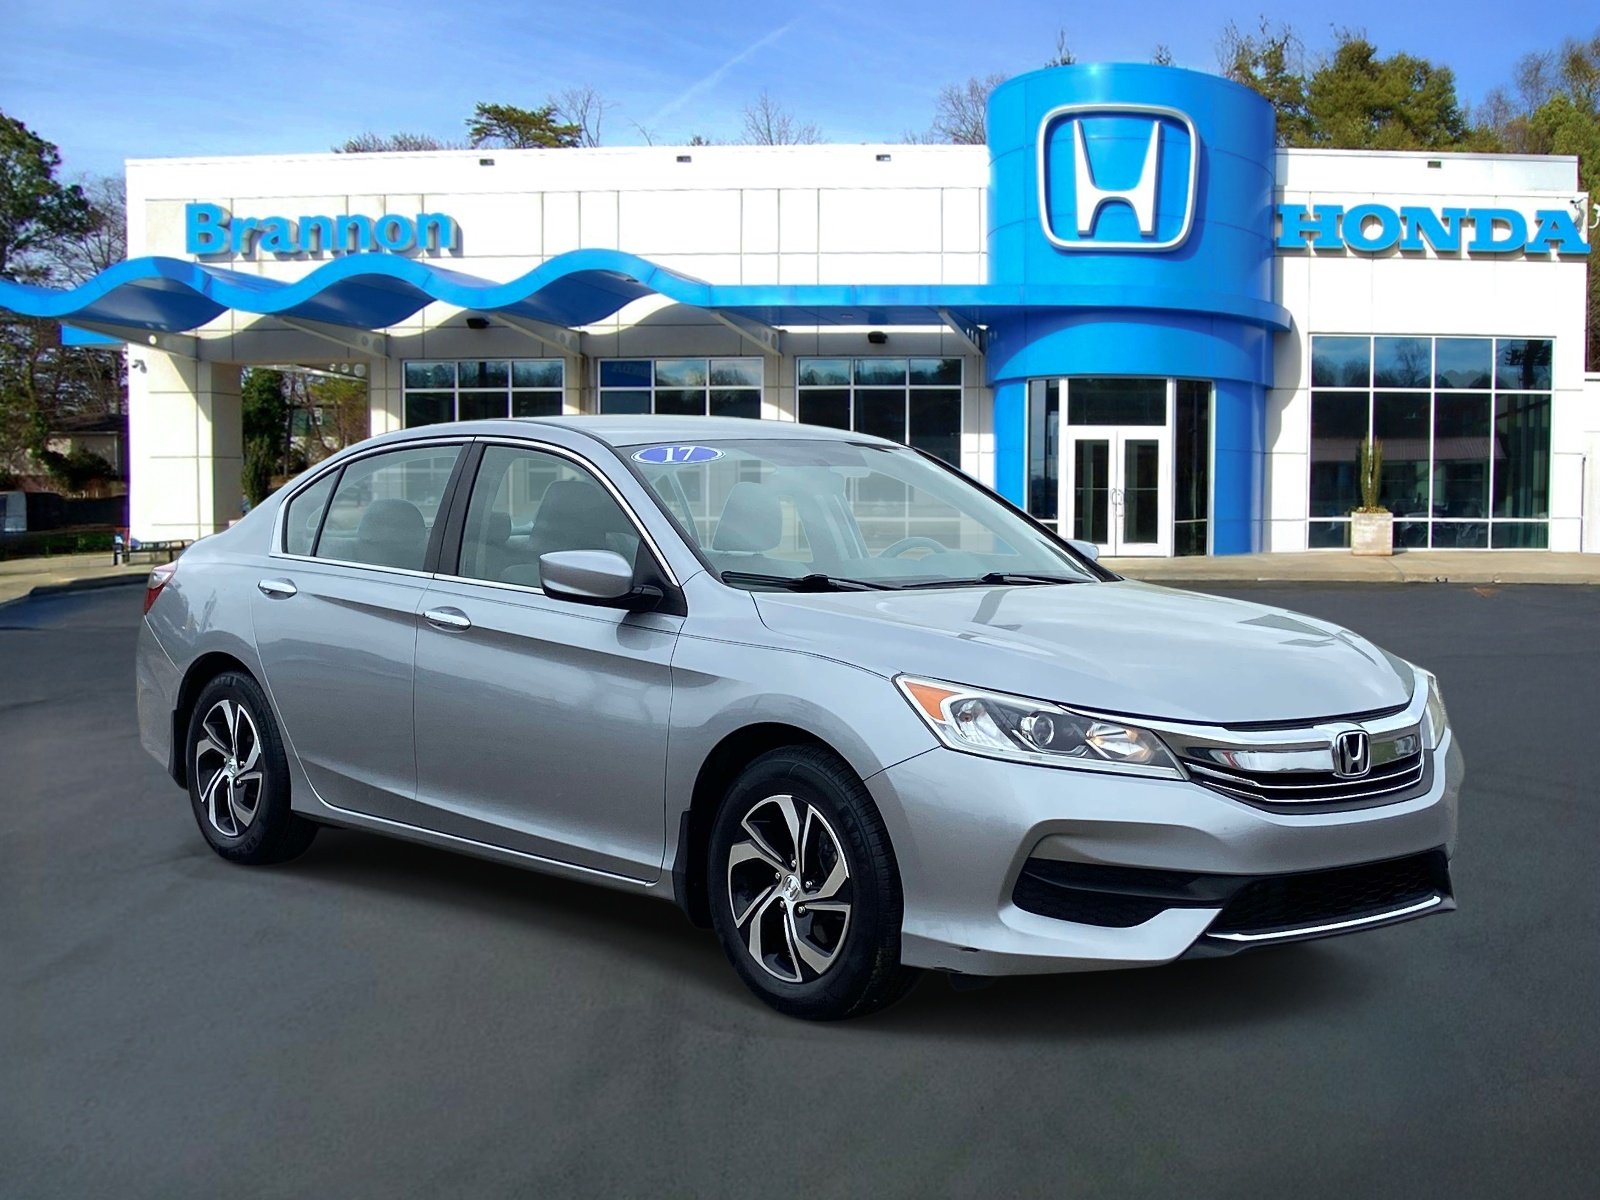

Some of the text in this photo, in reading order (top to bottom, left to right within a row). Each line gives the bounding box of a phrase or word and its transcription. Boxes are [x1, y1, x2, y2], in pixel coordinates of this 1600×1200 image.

[186, 202, 460, 259] Brannon
[1277, 203, 1591, 254] HONDA
[662, 446, 696, 463] 17
